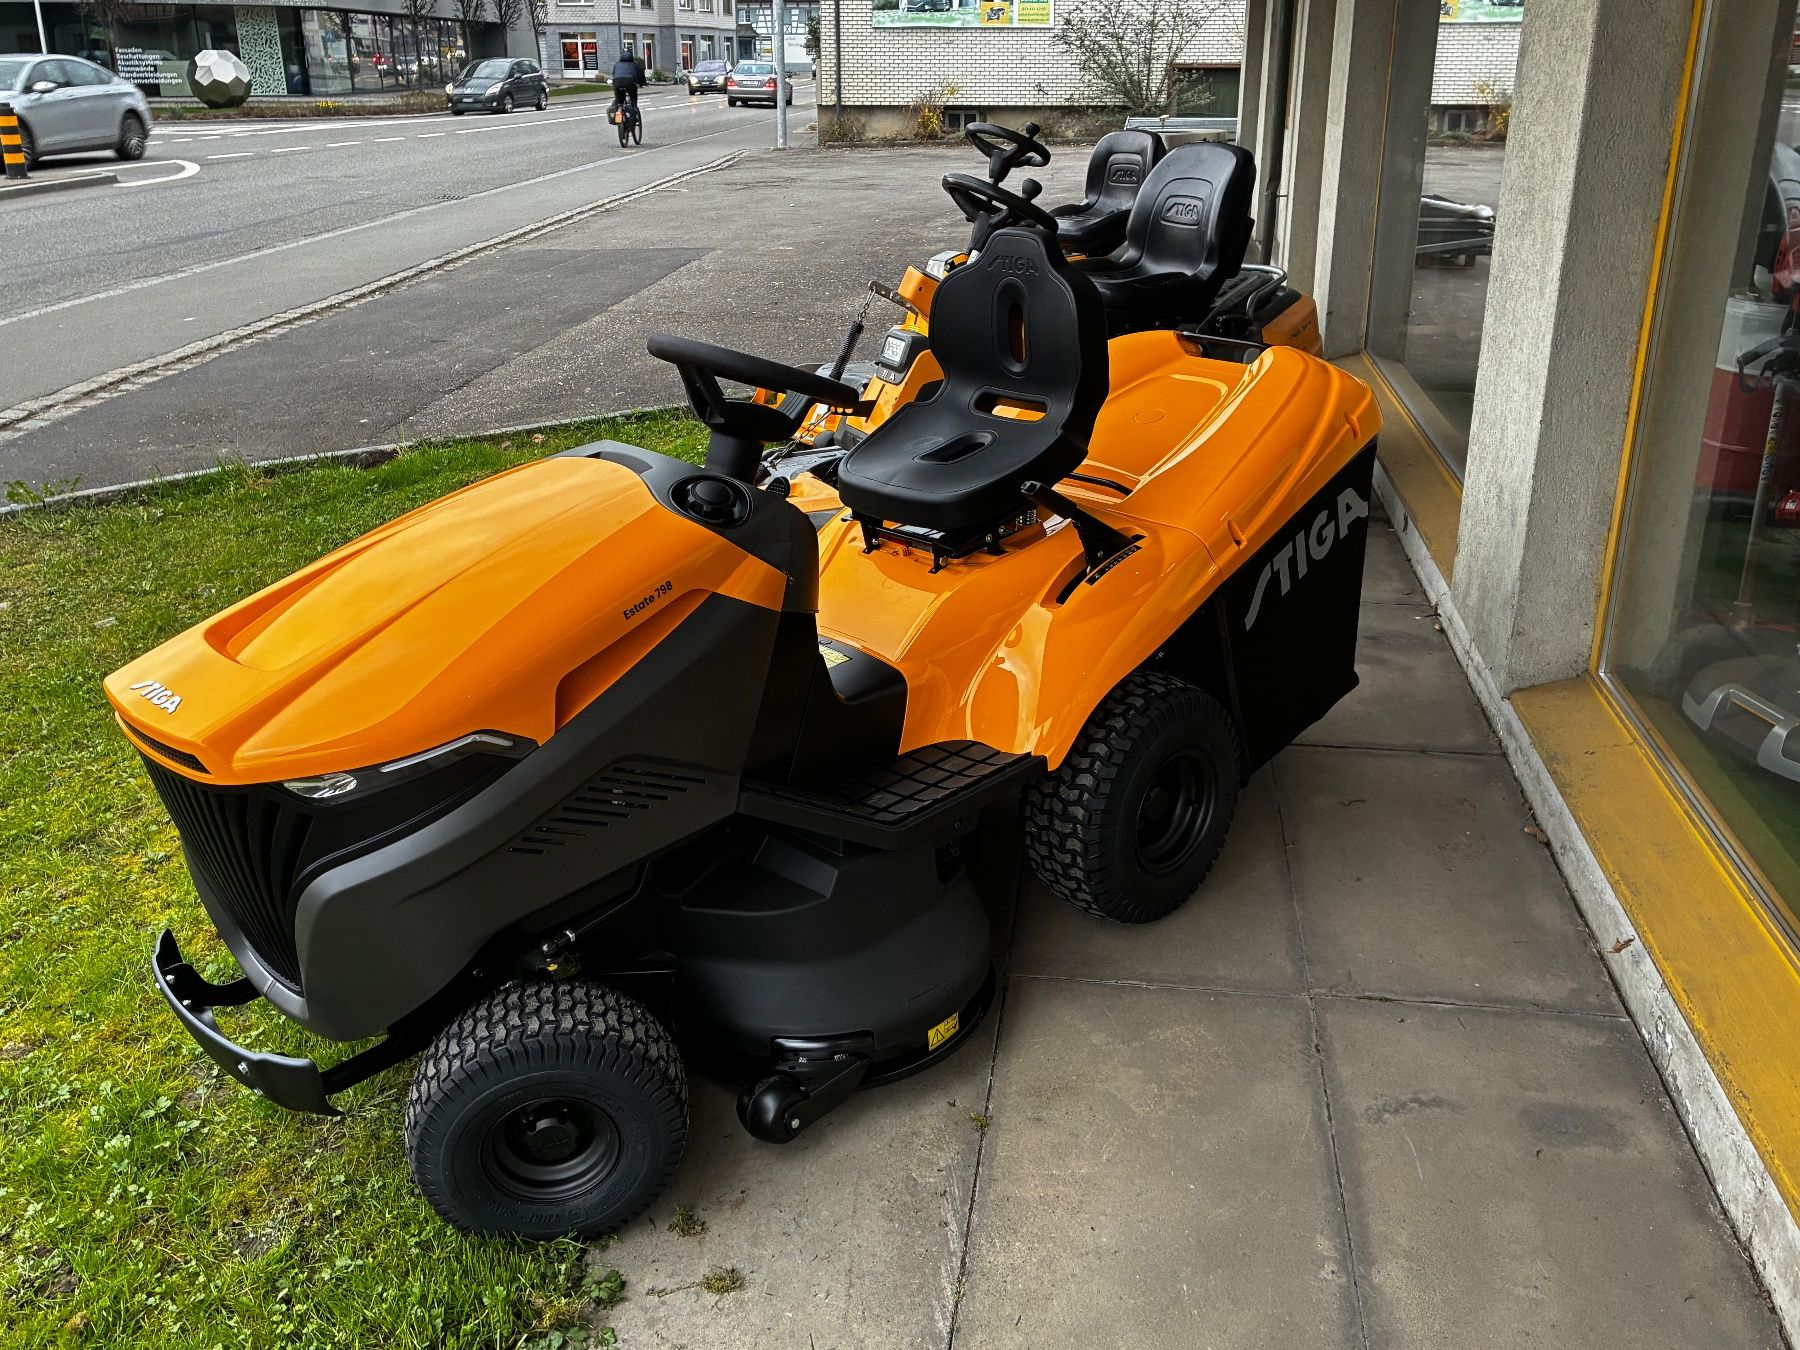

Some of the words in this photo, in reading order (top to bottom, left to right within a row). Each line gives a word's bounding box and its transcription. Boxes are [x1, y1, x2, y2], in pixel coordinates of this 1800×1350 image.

[1112, 169, 1137, 181] STIGA
[1166, 202, 1199, 220] STIGA
[987, 254, 1039, 276] STIGA
[1245, 488, 1369, 632] STIGA
[623, 594, 655, 620] Estate
[654, 580, 673, 598] 798
[130, 680, 182, 715] STIGA
